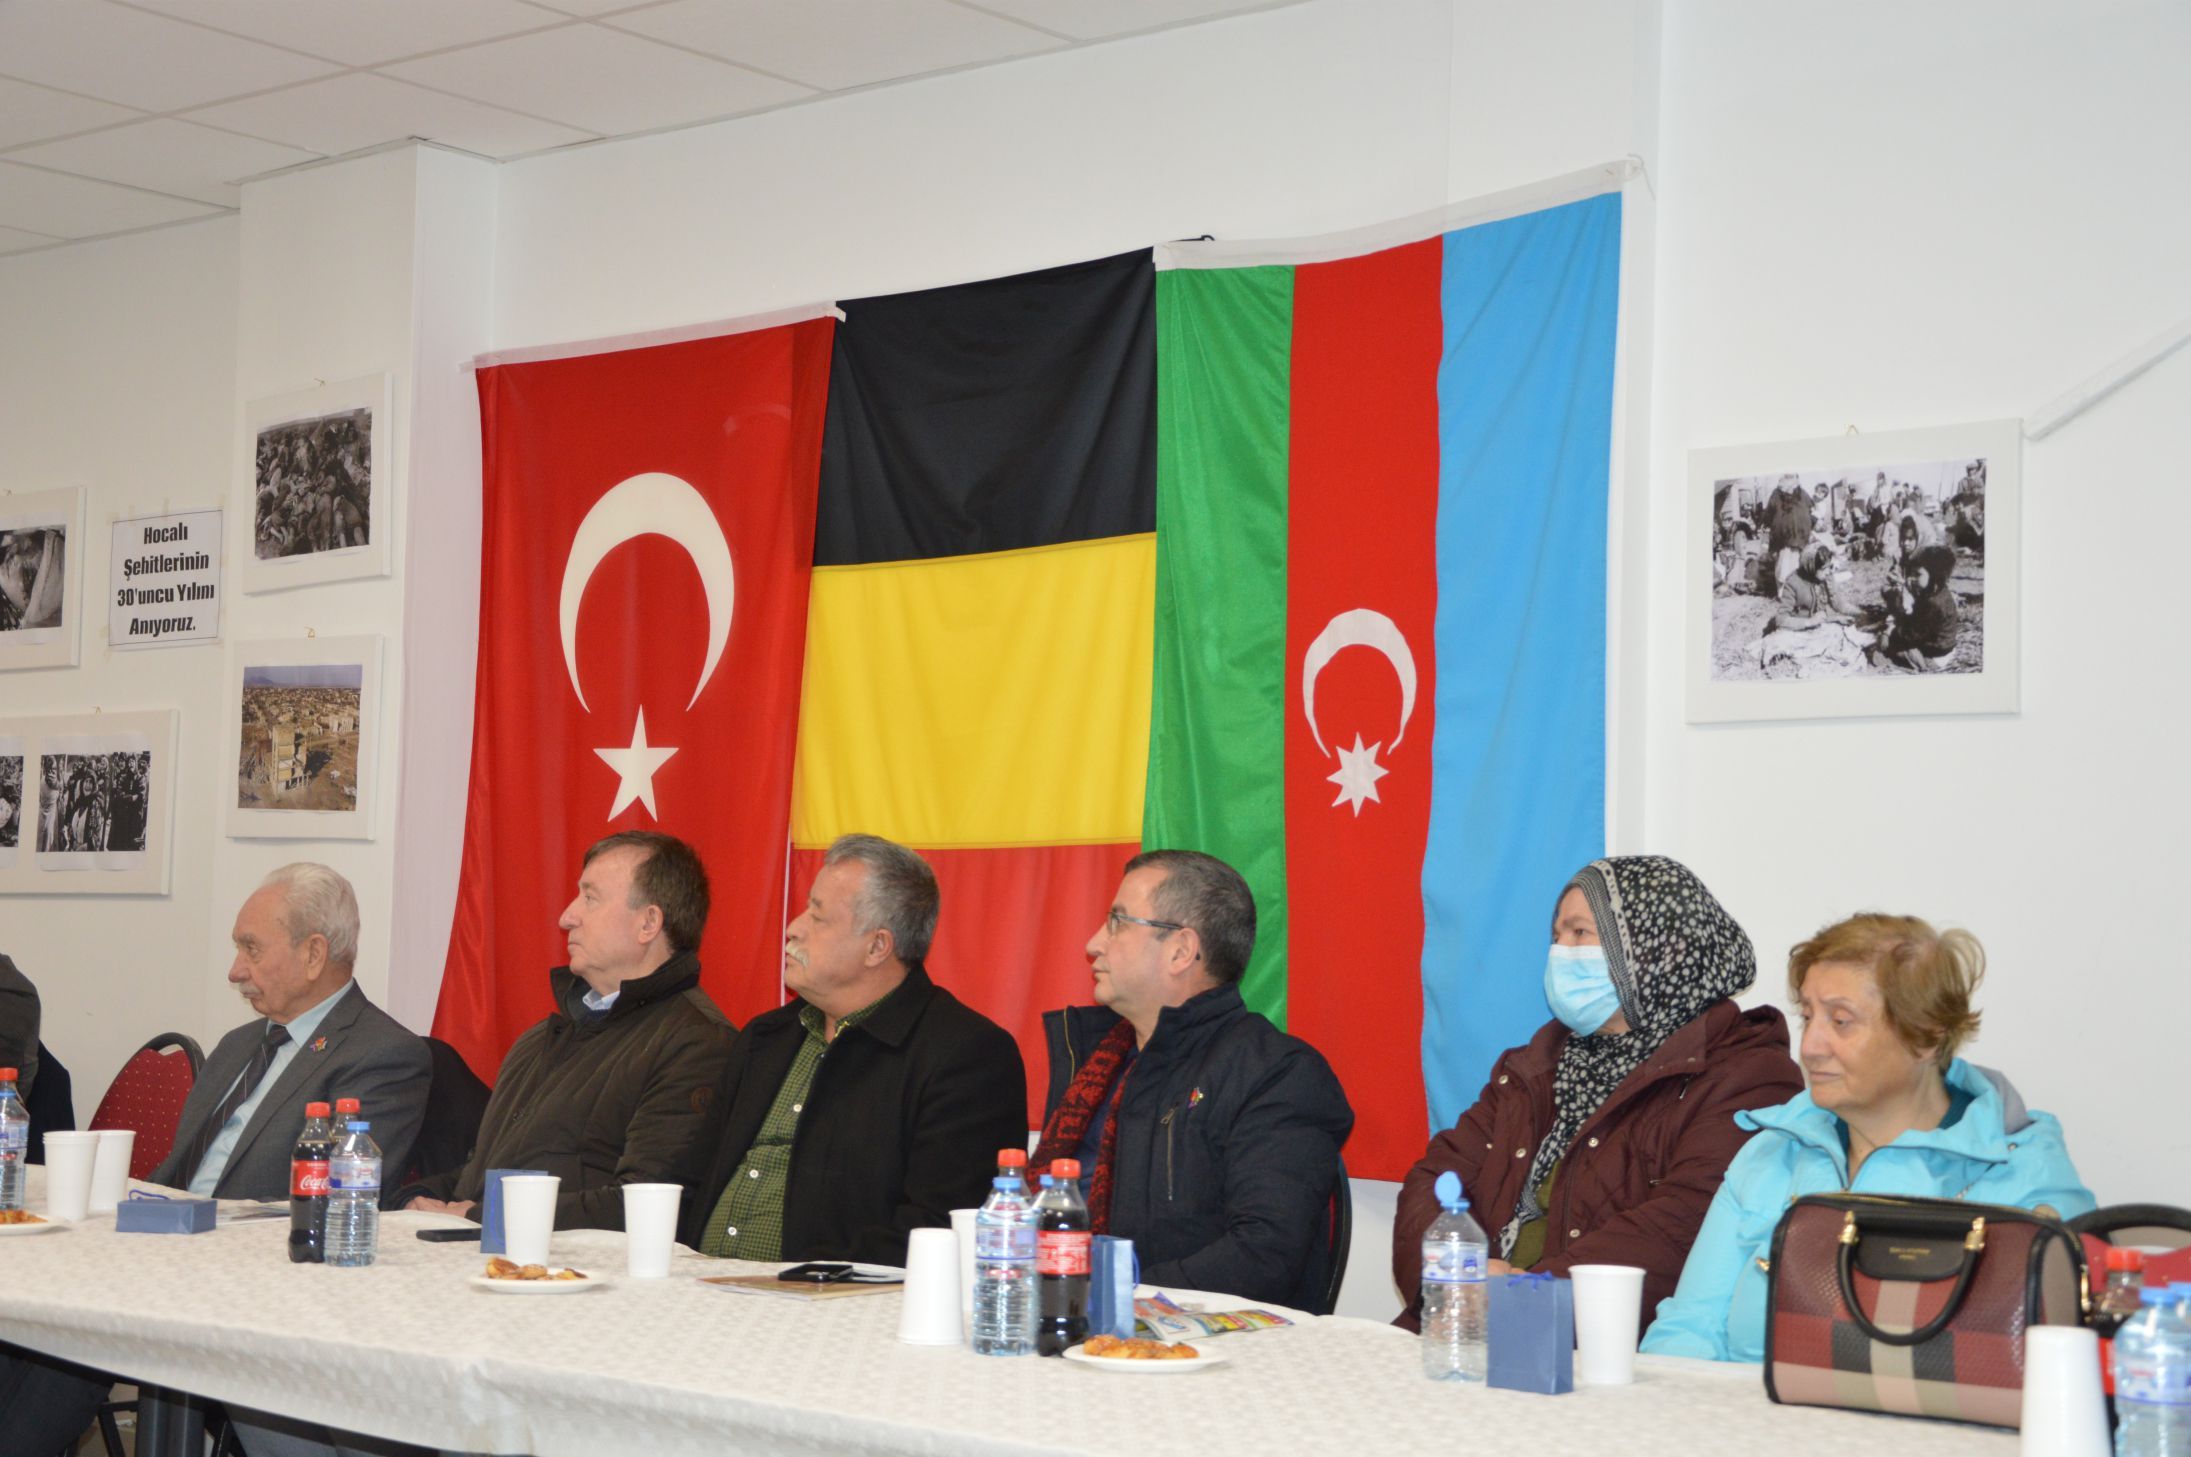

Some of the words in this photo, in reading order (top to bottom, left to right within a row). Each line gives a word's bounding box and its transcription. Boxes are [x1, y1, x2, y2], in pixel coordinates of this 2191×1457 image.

[143, 522, 188, 545] Hocalı
[124, 551, 209, 581] Şehitlerinin
[117, 588, 174, 607] 30'uncu
[177, 582, 215, 601] Yılını
[129, 616, 196, 637] Anıyoruz.
